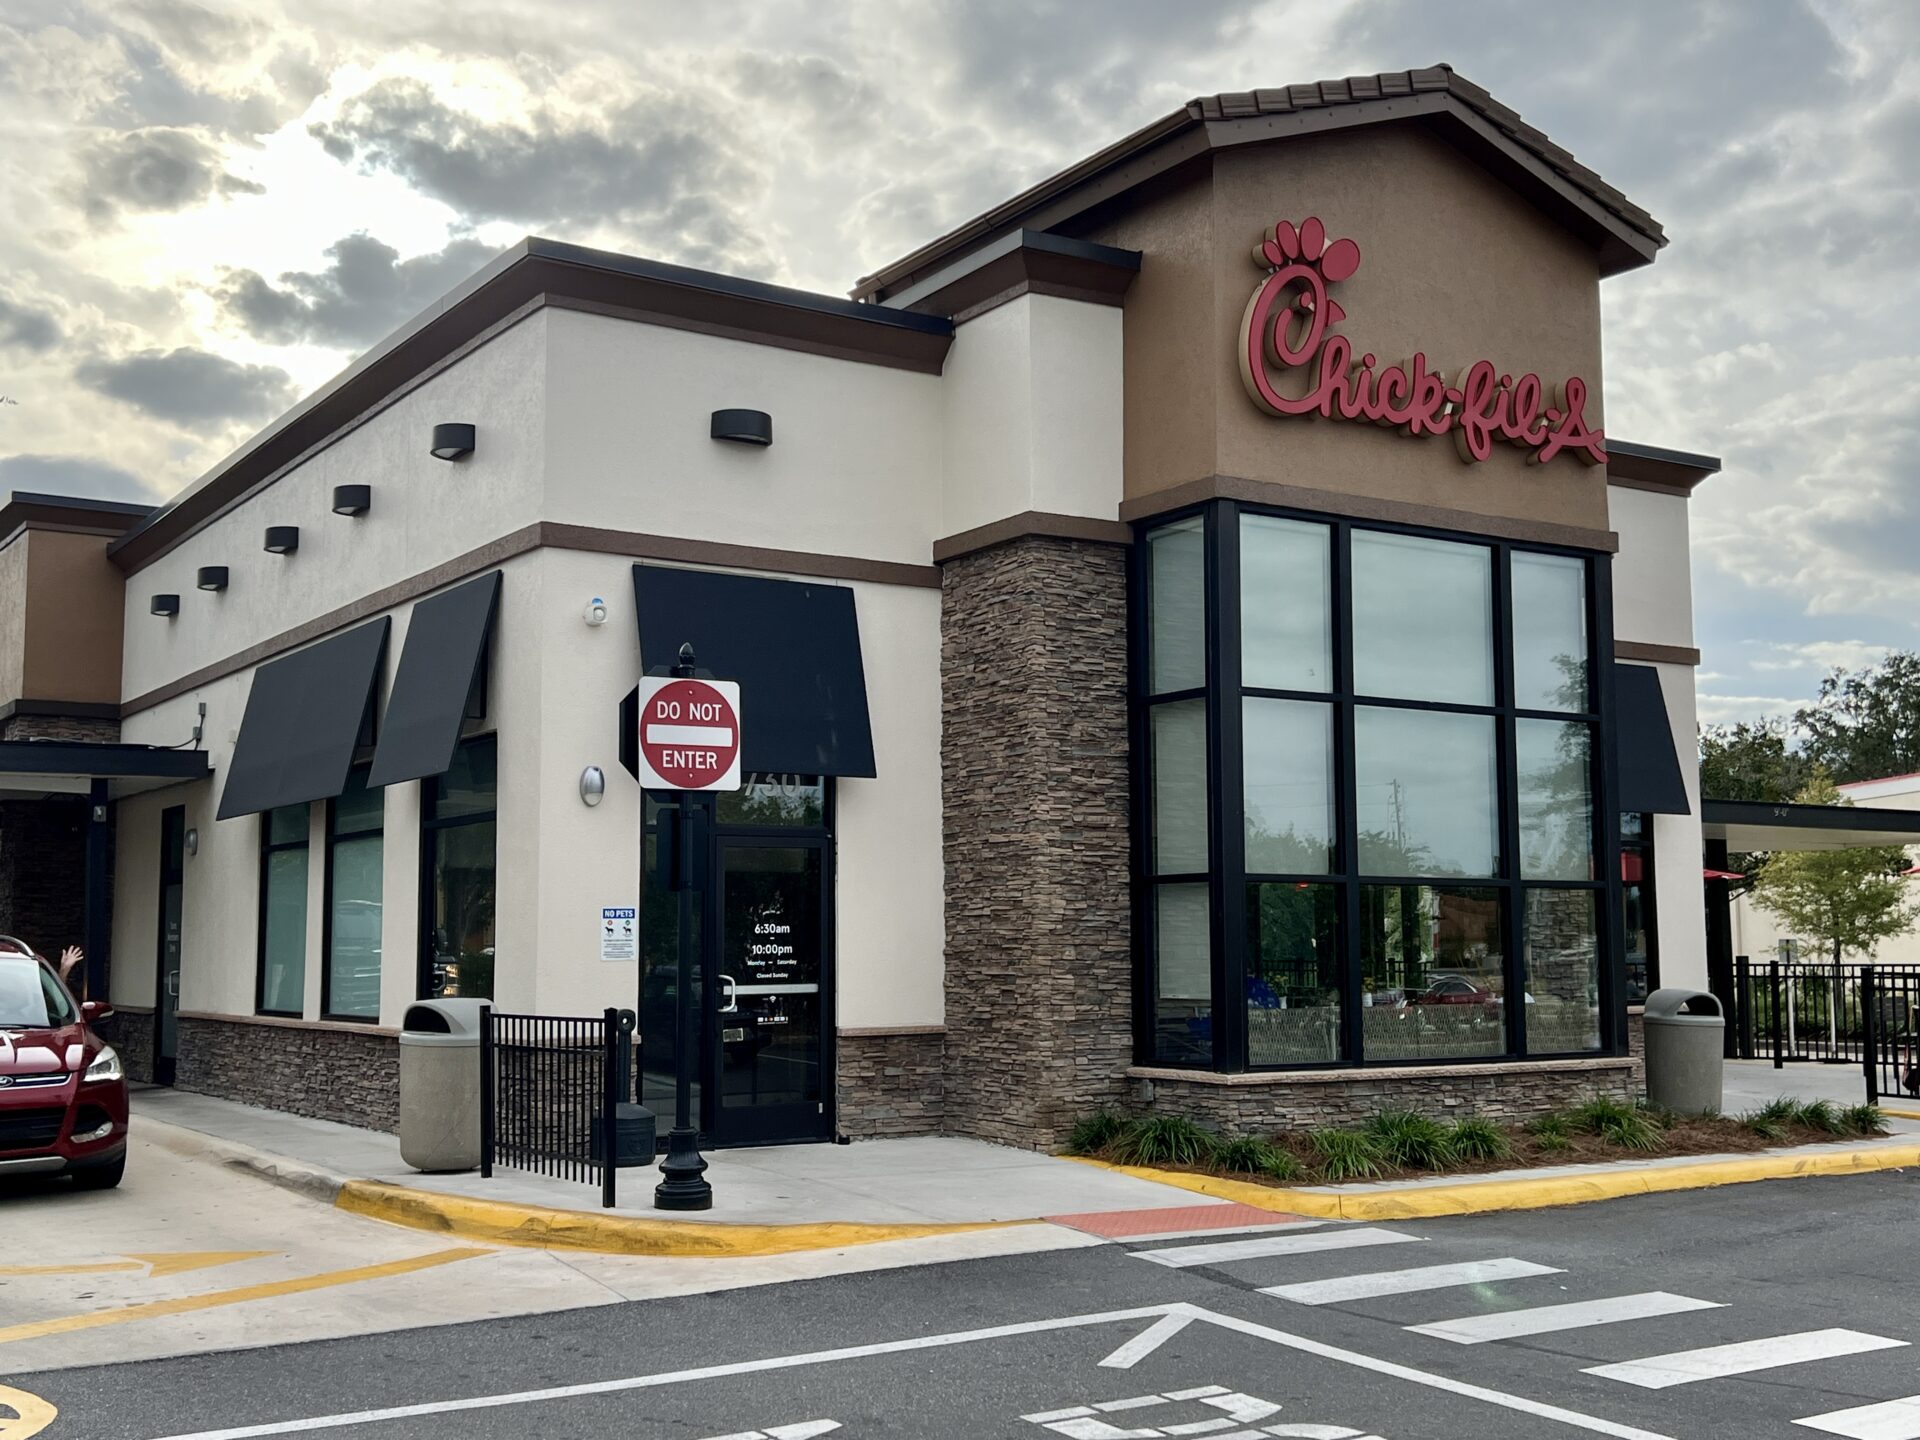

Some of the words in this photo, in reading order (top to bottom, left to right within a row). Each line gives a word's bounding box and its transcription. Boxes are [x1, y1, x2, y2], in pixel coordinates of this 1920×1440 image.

[1242, 258, 1609, 464] Chick-fil-A
[657, 701, 680, 719] DO
[689, 703, 722, 721] NOT
[662, 750, 717, 769] ENTER
[604, 909, 615, 918] NO
[616, 910, 634, 918] PETS
[754, 923, 790, 934] 6:30am
[752, 944, 793, 956] 10:00pm
